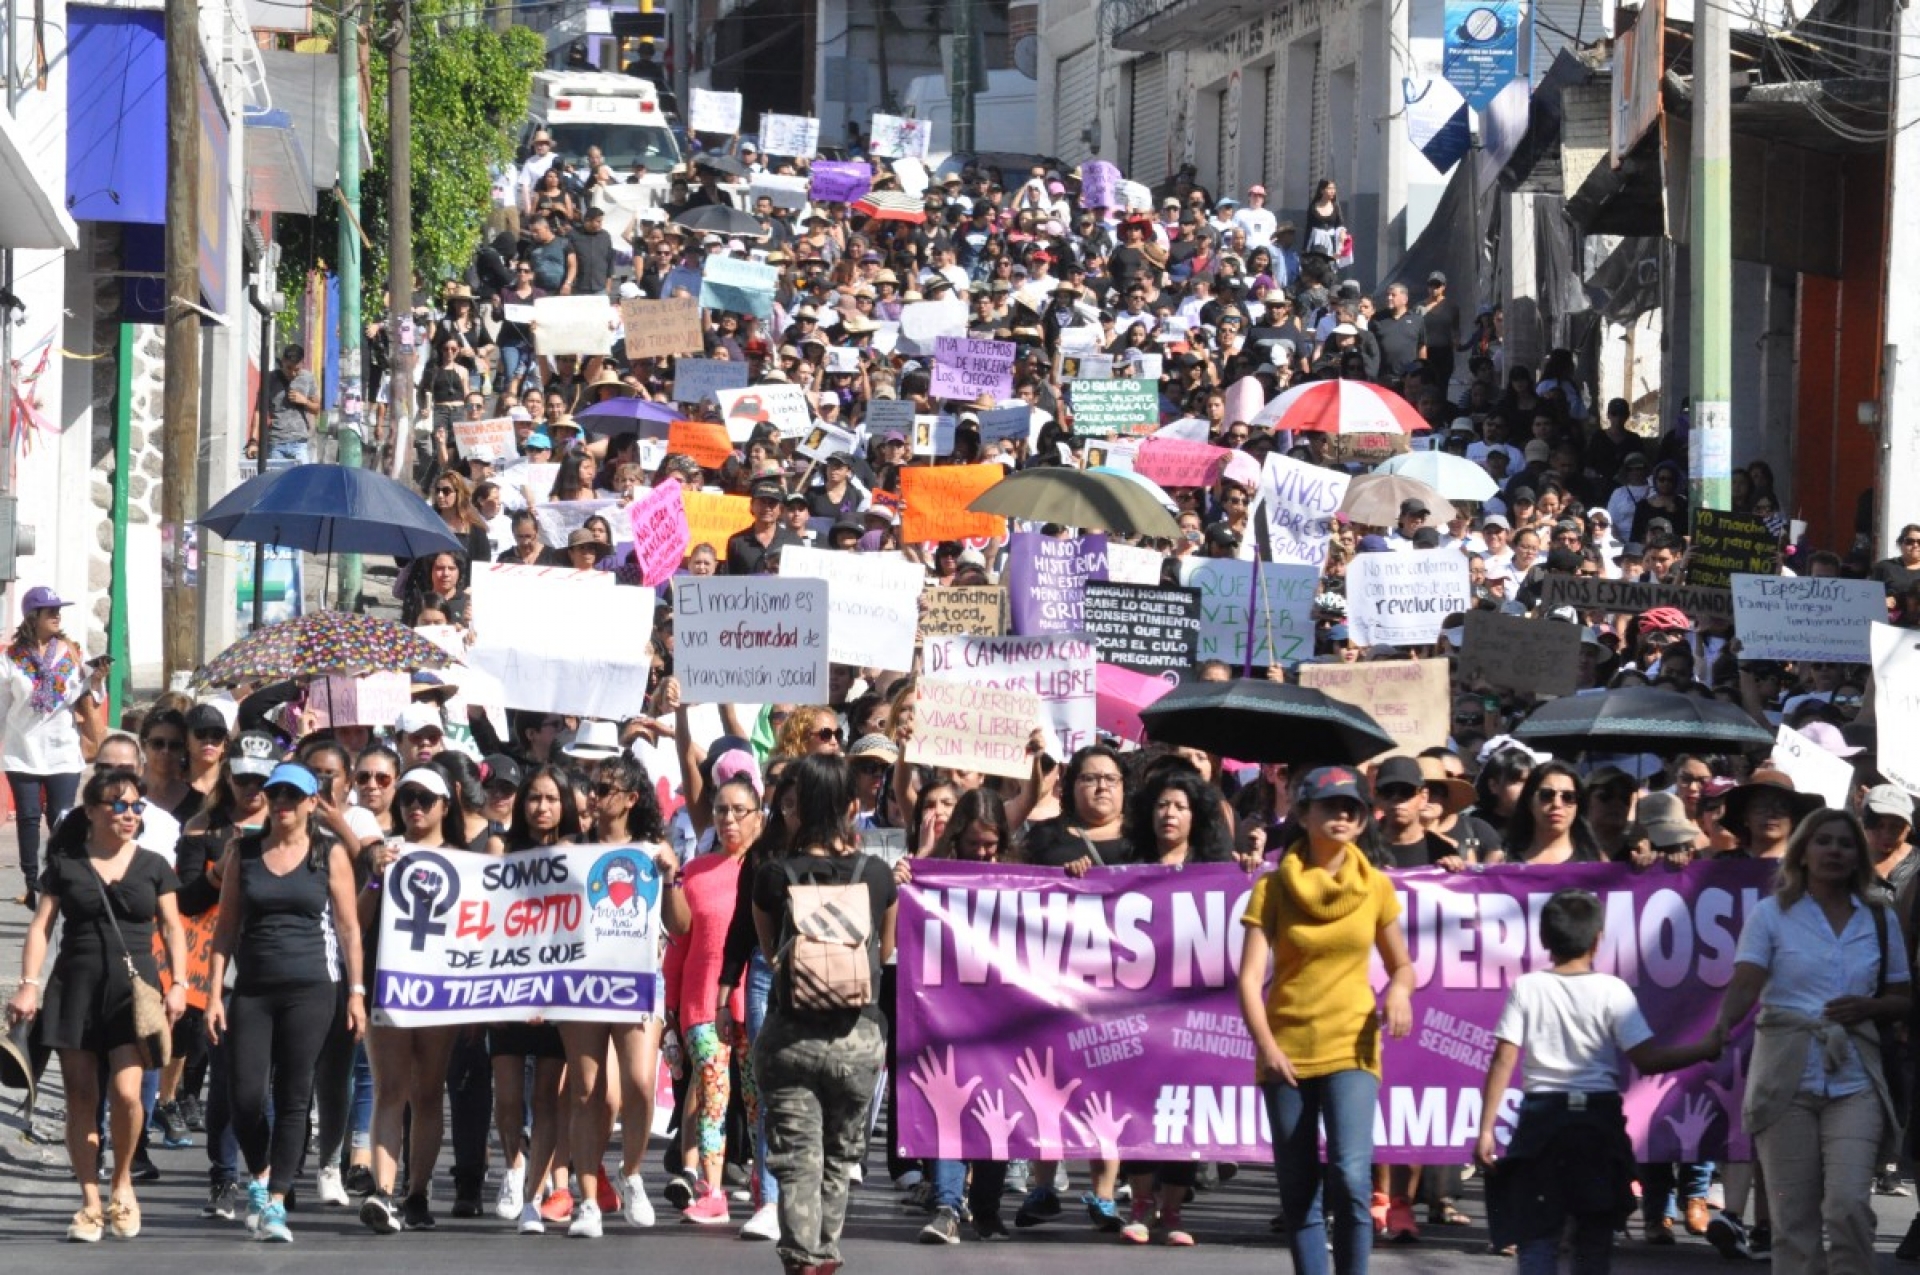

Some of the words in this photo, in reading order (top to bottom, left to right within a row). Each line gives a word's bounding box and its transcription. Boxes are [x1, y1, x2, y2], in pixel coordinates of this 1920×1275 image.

[678, 583, 702, 616] El
[708, 583, 790, 611] machismo
[795, 590, 814, 612] es
[937, 587, 998, 604] mañana
[1138, 588, 1193, 604] HOMBRE
[1375, 594, 1465, 614] revolución
[1550, 579, 1590, 601] NOS
[1085, 597, 1119, 609] SABE
[1122, 600, 1137, 610] LO
[1140, 601, 1165, 613] QUE
[1168, 604, 1185, 616] ES
[681, 630, 709, 647] una
[719, 621, 798, 650] enfermedad
[803, 629, 820, 649] de
[1085, 622, 1129, 635] HASTA
[1134, 625, 1161, 638] QUE
[1166, 628, 1183, 639] LE
[932, 640, 953, 672] DE
[964, 638, 1043, 667] CAMINO
[1046, 642, 1056, 659] A
[1058, 639, 1092, 661] CASA
[1130, 639, 1148, 650] EL
[1151, 641, 1188, 653] CULO
[684, 662, 772, 688] transmisión
[776, 661, 816, 688] social
[1035, 668, 1095, 698] LIBRE
[960, 685, 1039, 716] QUEREMOS
[914, 735, 928, 755] Y
[934, 736, 963, 756] SIN
[482, 854, 569, 891] SOMOS
[456, 899, 495, 940] EL
[504, 893, 582, 937] GRITO
[446, 948, 485, 969] DE
[489, 946, 531, 969] LAS
[539, 942, 587, 964] QUE
[385, 975, 434, 1007] NO
[442, 974, 553, 1006] TIENEN
[563, 974, 639, 1006] VOZ
[1067, 1014, 1149, 1053] MUJERES
[1171, 1028, 1256, 1060] TRANQUIL
[1083, 1036, 1145, 1069] LIBRES
